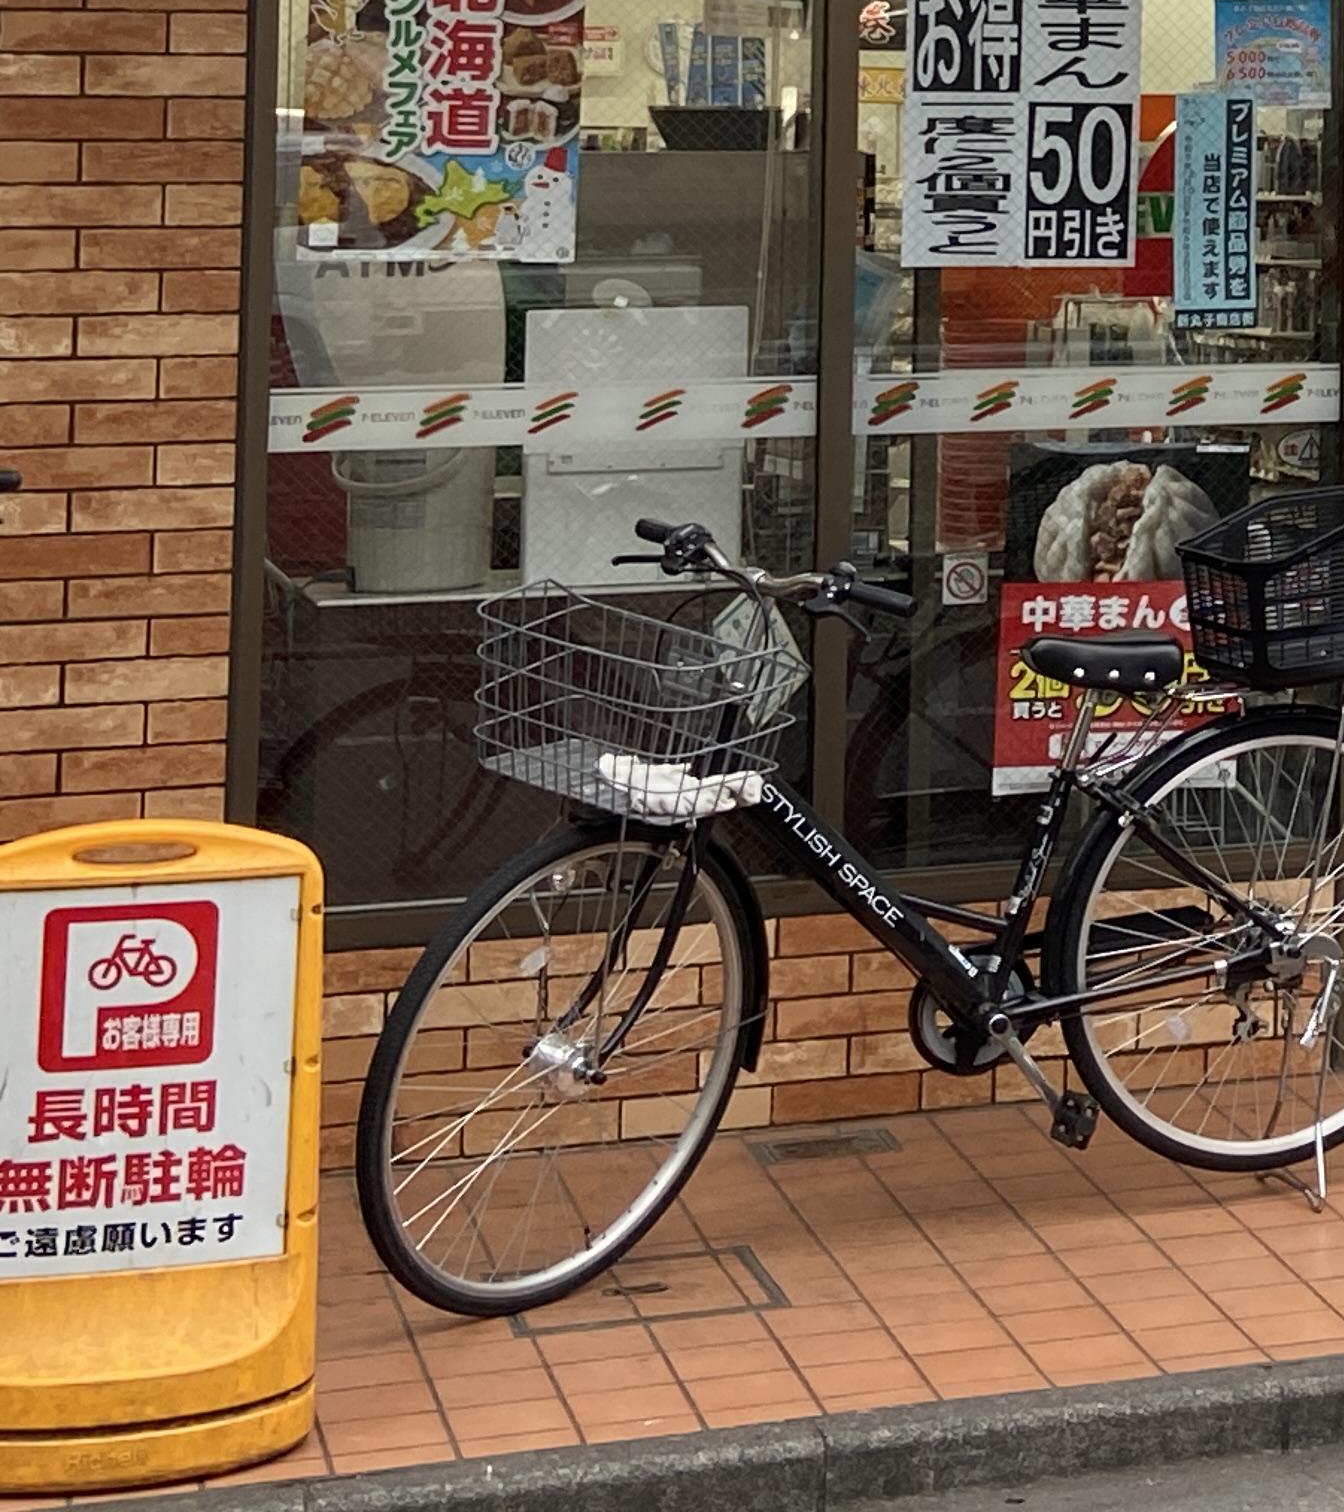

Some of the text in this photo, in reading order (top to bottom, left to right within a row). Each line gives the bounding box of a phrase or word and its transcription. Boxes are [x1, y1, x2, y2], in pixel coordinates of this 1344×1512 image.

[1029, 105, 1128, 206] 50
[1026, 206, 1125, 258] 円引き
[1202, 152, 1222, 300] 当店で使えます
[1021, 594, 1165, 633] 中華まん
[1012, 701, 1063, 720] 買うと
[761, 783, 905, 928] STYLISH SPACE
[101, 1011, 202, 1053] お客様専用
[27, 1080, 218, 1144] 長時間
[0, 1143, 247, 1214] 無断駐輪
[0, 1212, 245, 1259] ご遠慮願います
